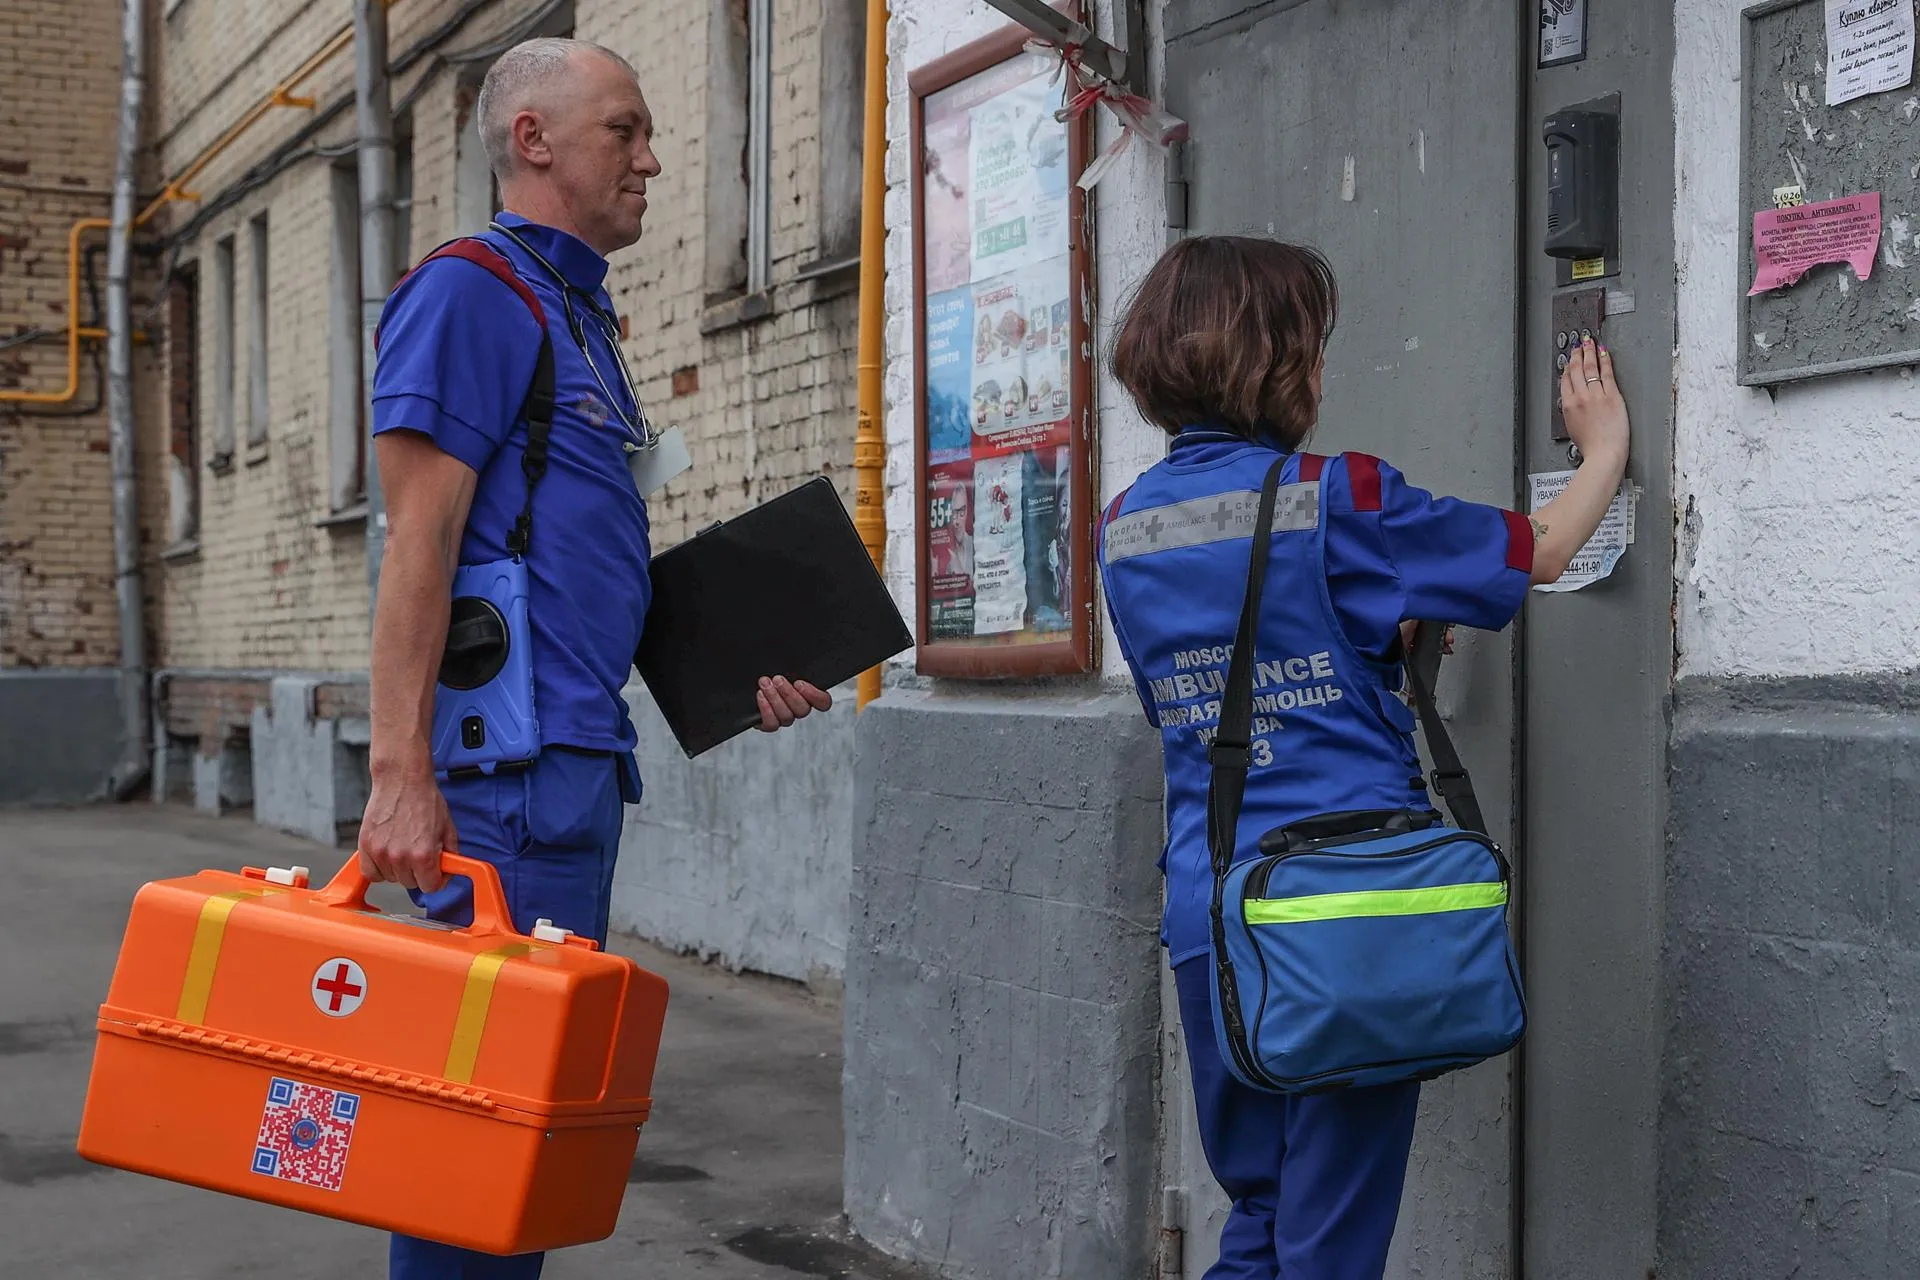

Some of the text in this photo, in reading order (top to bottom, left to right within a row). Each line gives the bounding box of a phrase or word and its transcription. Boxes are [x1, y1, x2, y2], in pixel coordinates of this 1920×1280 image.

[1840, 9, 1865, 27] Куплю
[1776, 212, 1805, 223] ПОКУПКА
[1811, 203, 1856, 217] АНТИКВАРИАТА
[930, 497, 953, 529] 55+
[1235, 497, 1292, 511] СКОАЯ
[1165, 515, 1206, 529] AMBULANCE
[1235, 511, 1290, 524] ПОЩЬ
[1173, 644, 1257, 669] MOSCO
[1148, 651, 1334, 703] MBULNCE
[1158, 684, 1343, 727] СКОРАЯ МОЩЬ
